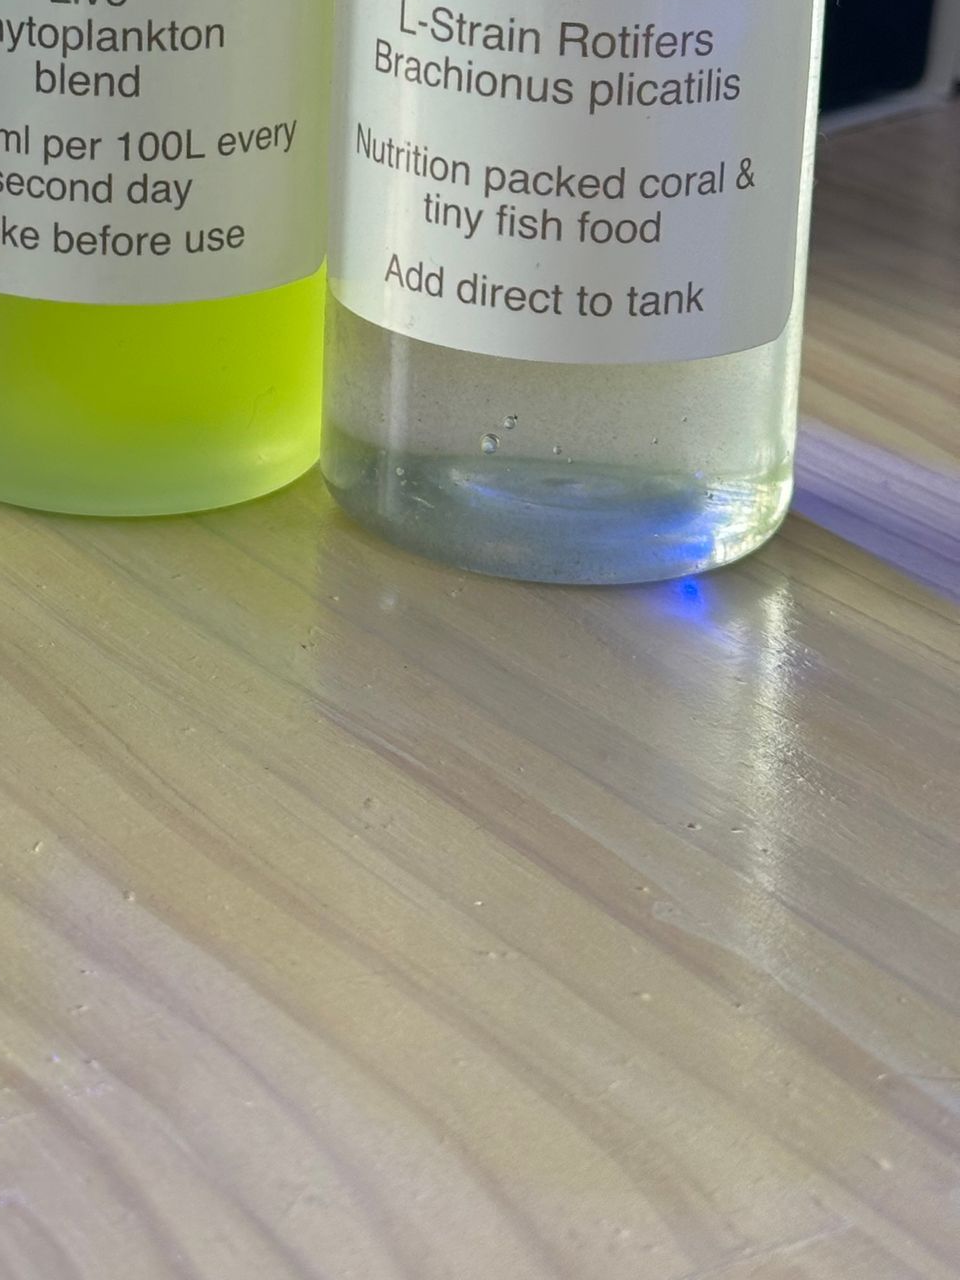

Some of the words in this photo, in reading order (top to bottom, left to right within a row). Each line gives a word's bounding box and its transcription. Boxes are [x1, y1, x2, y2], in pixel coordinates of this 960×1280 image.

[400, 0, 540, 55] L-Strain
[559, 22, 714, 59] Rotifers
[35, 60, 141, 98] blend
[375, 39, 574, 105] Brachionus
[589, 68, 740, 114] plicatilis
[43, 134, 101, 166] per
[117, 129, 205, 162] 100L
[217, 120, 297, 157] every
[356, 122, 471, 186] Nutrition
[484, 164, 625, 200] packed
[640, 162, 724, 200] coral
[736, 158, 755, 190] &
[126, 173, 192, 211] day
[53, 222, 171, 256] before
[185, 222, 245, 253] use
[423, 193, 483, 239] tiny
[496, 205, 563, 242] fish
[577, 212, 662, 244] food
[385, 253, 444, 299] Add
[456, 274, 563, 315] direct
[576, 286, 613, 318] to
[626, 282, 704, 318] tank
